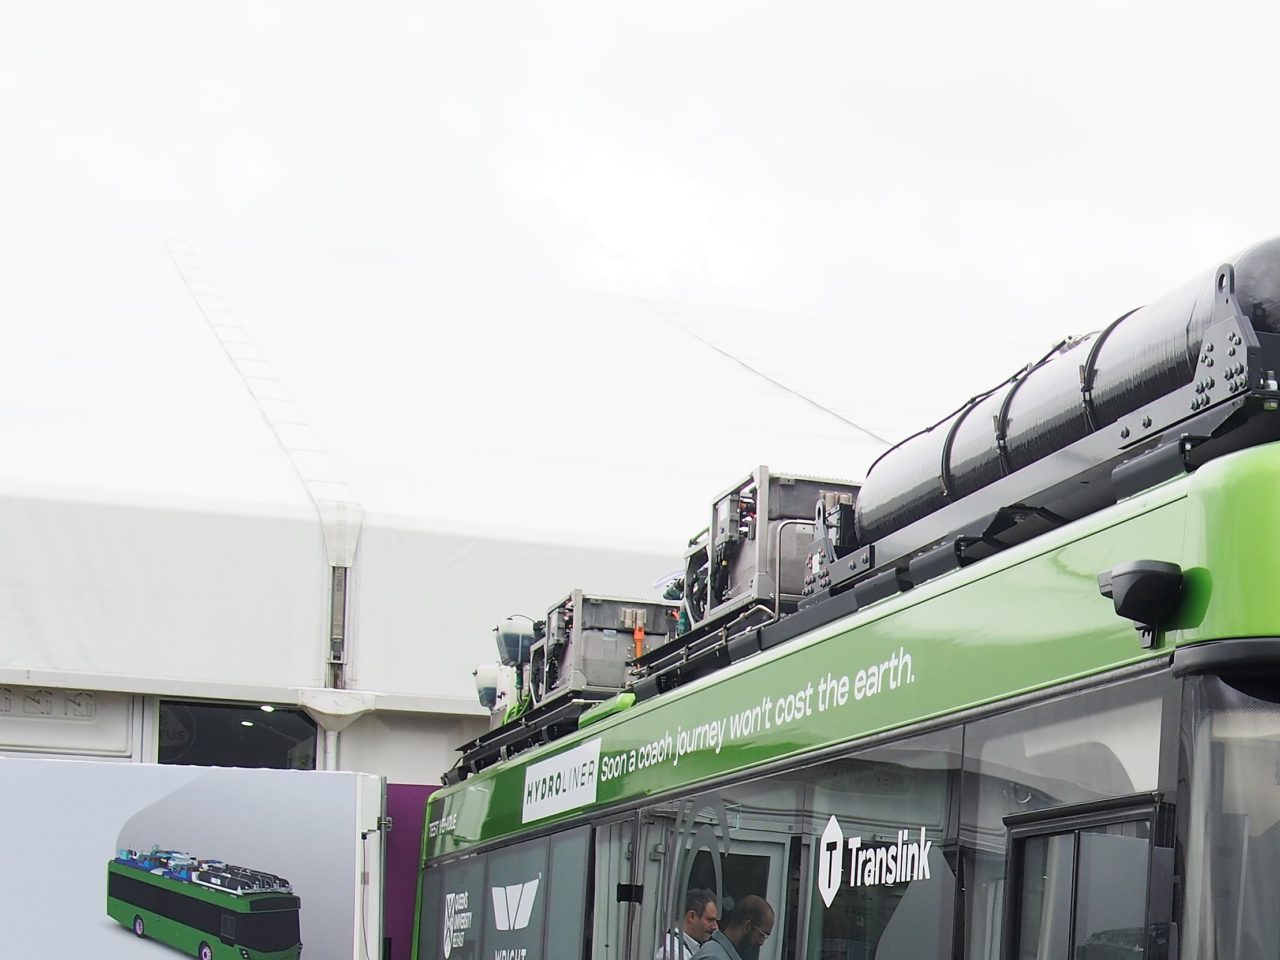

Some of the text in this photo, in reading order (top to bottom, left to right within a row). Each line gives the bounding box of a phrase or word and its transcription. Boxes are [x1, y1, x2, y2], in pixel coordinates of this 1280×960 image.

[601, 646, 915, 782] Soon a coach journey won't cost the earth.
[526, 759, 596, 806] HYDROLINER
[848, 826, 933, 887] Translink
